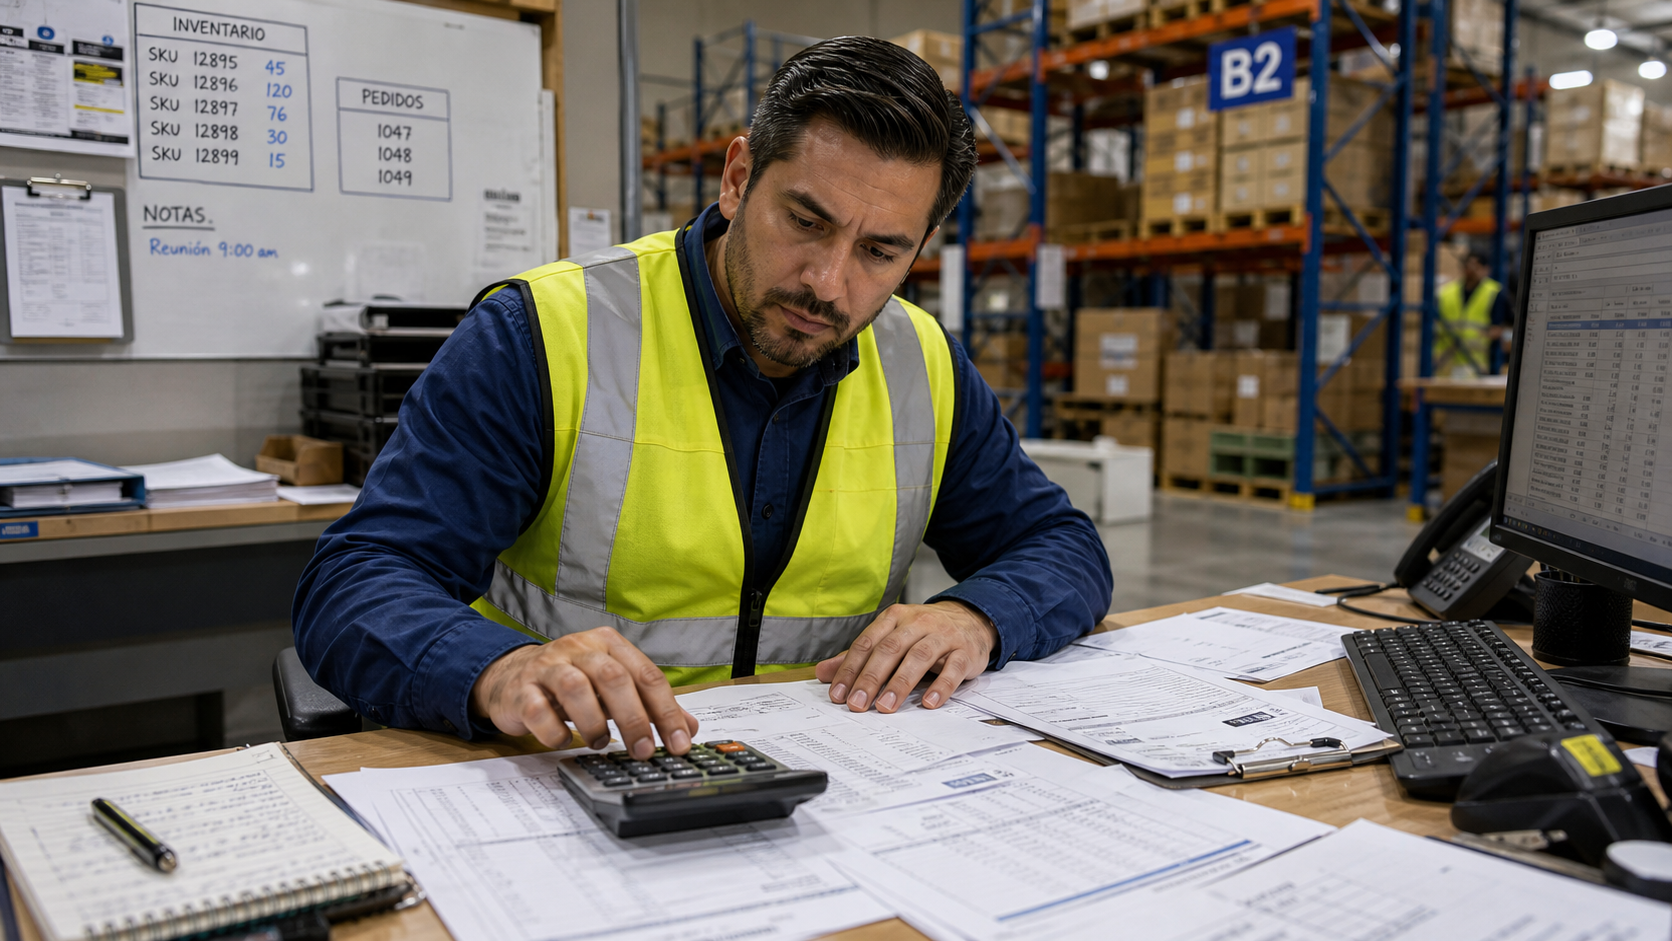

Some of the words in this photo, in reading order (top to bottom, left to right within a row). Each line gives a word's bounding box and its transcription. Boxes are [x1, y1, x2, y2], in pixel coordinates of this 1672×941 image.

[173, 16, 266, 42] INVENTARIO
[148, 47, 179, 64] SKU
[193, 51, 238, 70] 12895
[264, 60, 286, 76] 45
[1221, 41, 1282, 100] B2
[149, 71, 180, 88] SKU
[193, 75, 239, 93] 12896
[266, 82, 293, 99] 120
[149, 96, 180, 113] SKU
[194, 99, 239, 117] 12897
[266, 106, 288, 123] 76
[361, 88, 424, 110] PEDIDOS
[150, 120, 181, 137] SKU
[195, 123, 239, 141] 12898
[266, 129, 288, 145] 30
[377, 124, 413, 141] 1047
[151, 146, 182, 162] SKU
[195, 148, 239, 166] 12899
[269, 153, 286, 169] 15
[378, 146, 413, 164] 1048
[378, 169, 413, 187] 1049
[149, 238, 211, 257] Reunión
[217, 241, 255, 258] 9:00
